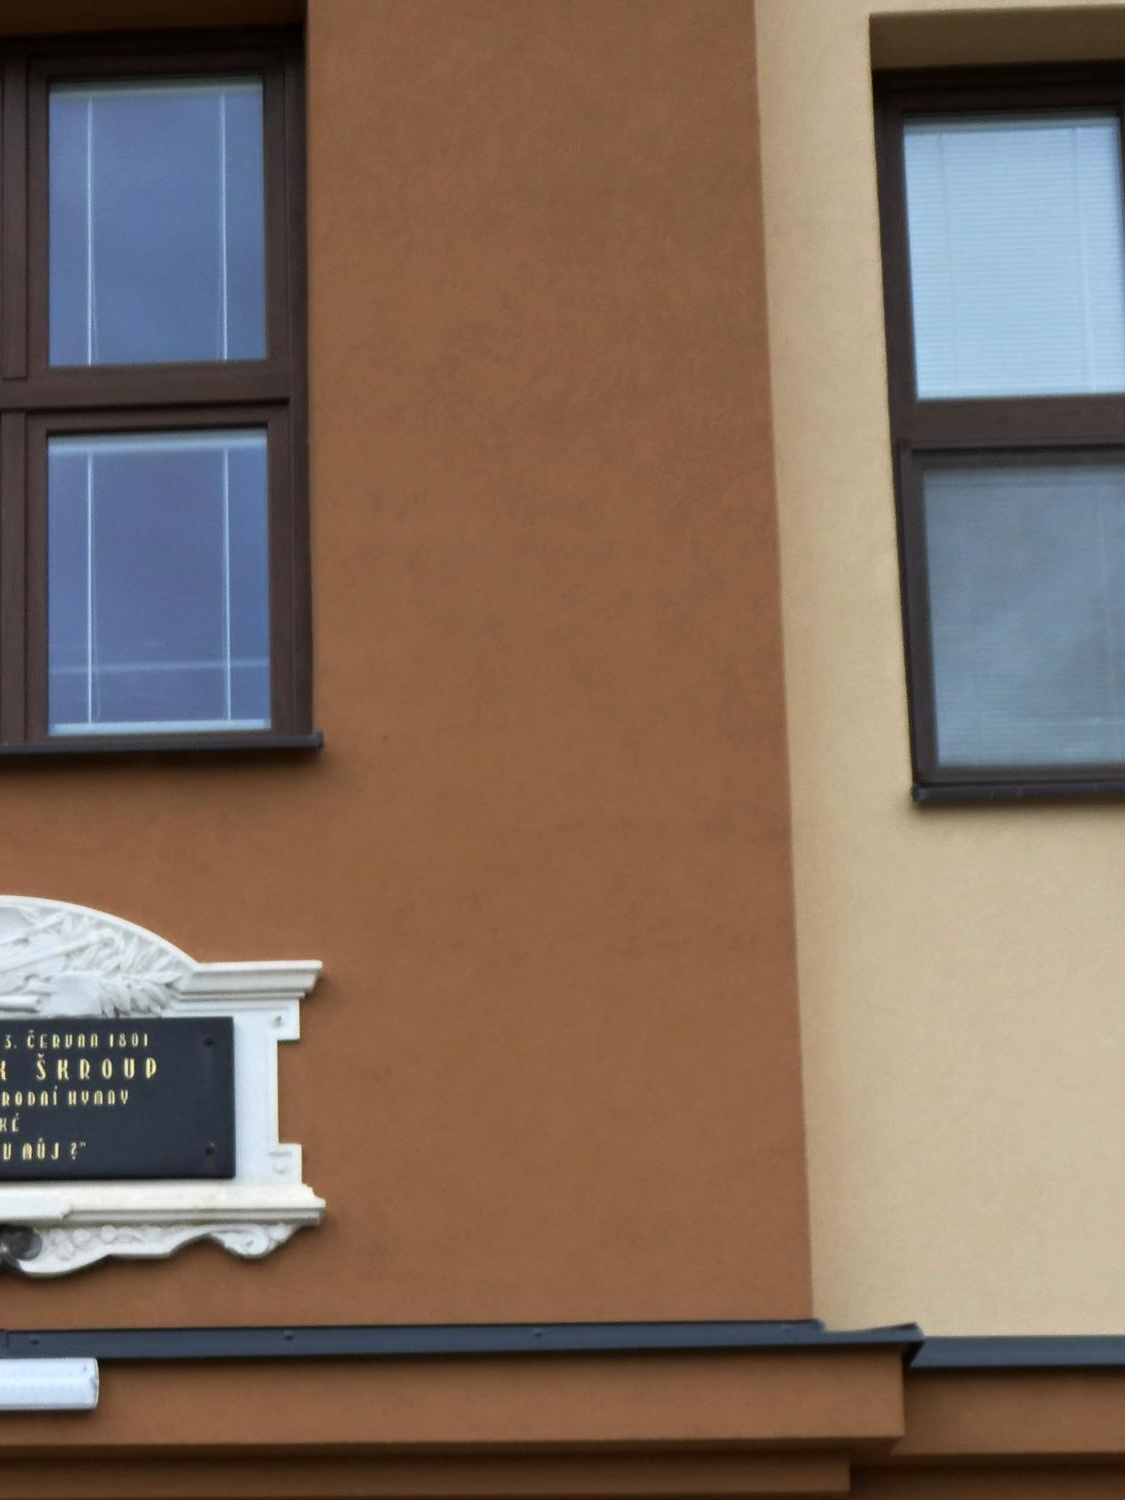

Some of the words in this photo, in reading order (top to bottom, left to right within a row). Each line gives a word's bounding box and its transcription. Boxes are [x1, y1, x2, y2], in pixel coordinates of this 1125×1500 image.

[3, 1033, 18, 1050] 3.
[26, 1028, 99, 1050] ČERVNA
[109, 1032, 149, 1049] 1801
[35, 1052, 158, 1081] ŠKROUP
[67, 1088, 130, 1107] HYMNY
[21, 1137, 61, 1161] MŮJ
